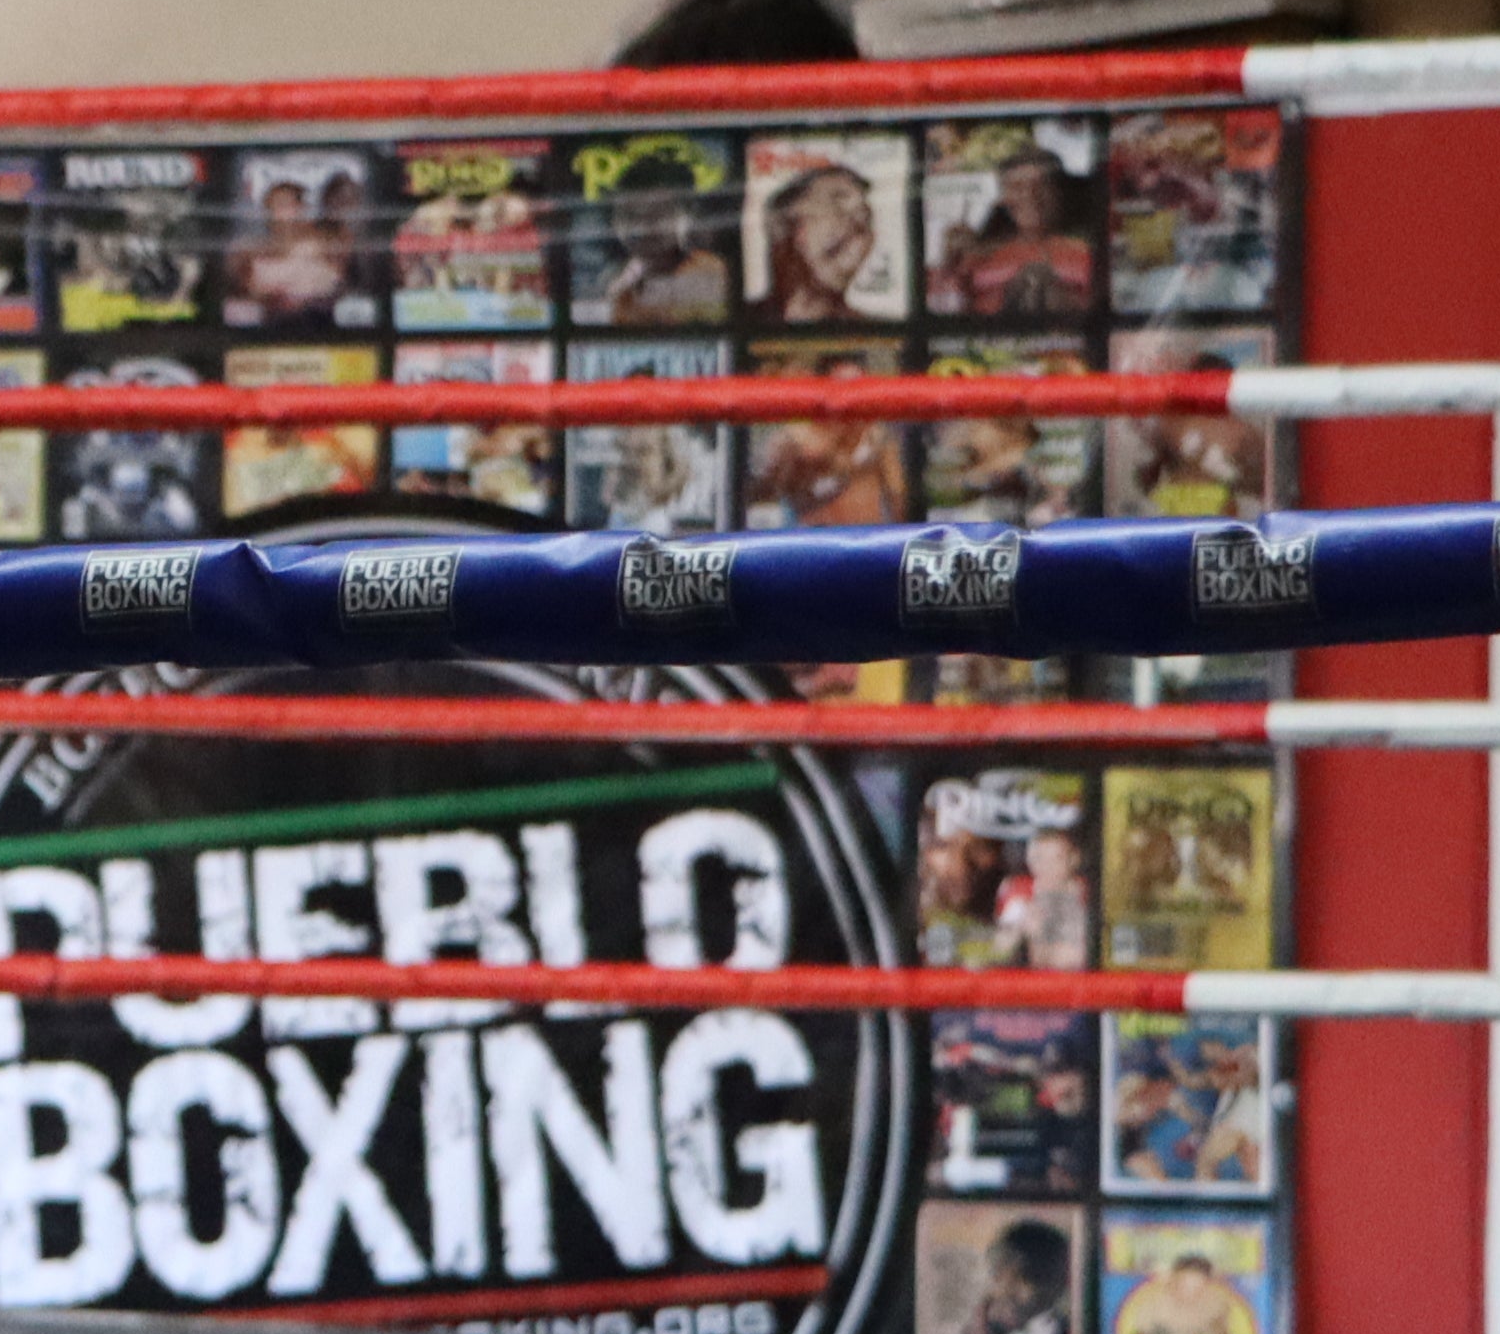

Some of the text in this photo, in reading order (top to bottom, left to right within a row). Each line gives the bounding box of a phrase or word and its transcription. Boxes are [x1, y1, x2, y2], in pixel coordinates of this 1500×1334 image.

[91, 558, 189, 581] PUEBLO
[352, 558, 452, 579] PUEBLO
[626, 550, 726, 576] PUEBLO
[87, 578, 187, 610] BOXING
[347, 576, 448, 611] BOXING
[625, 572, 725, 608] BOXING
[907, 572, 1012, 606] BOXING
[1201, 565, 1306, 603] BOXING
